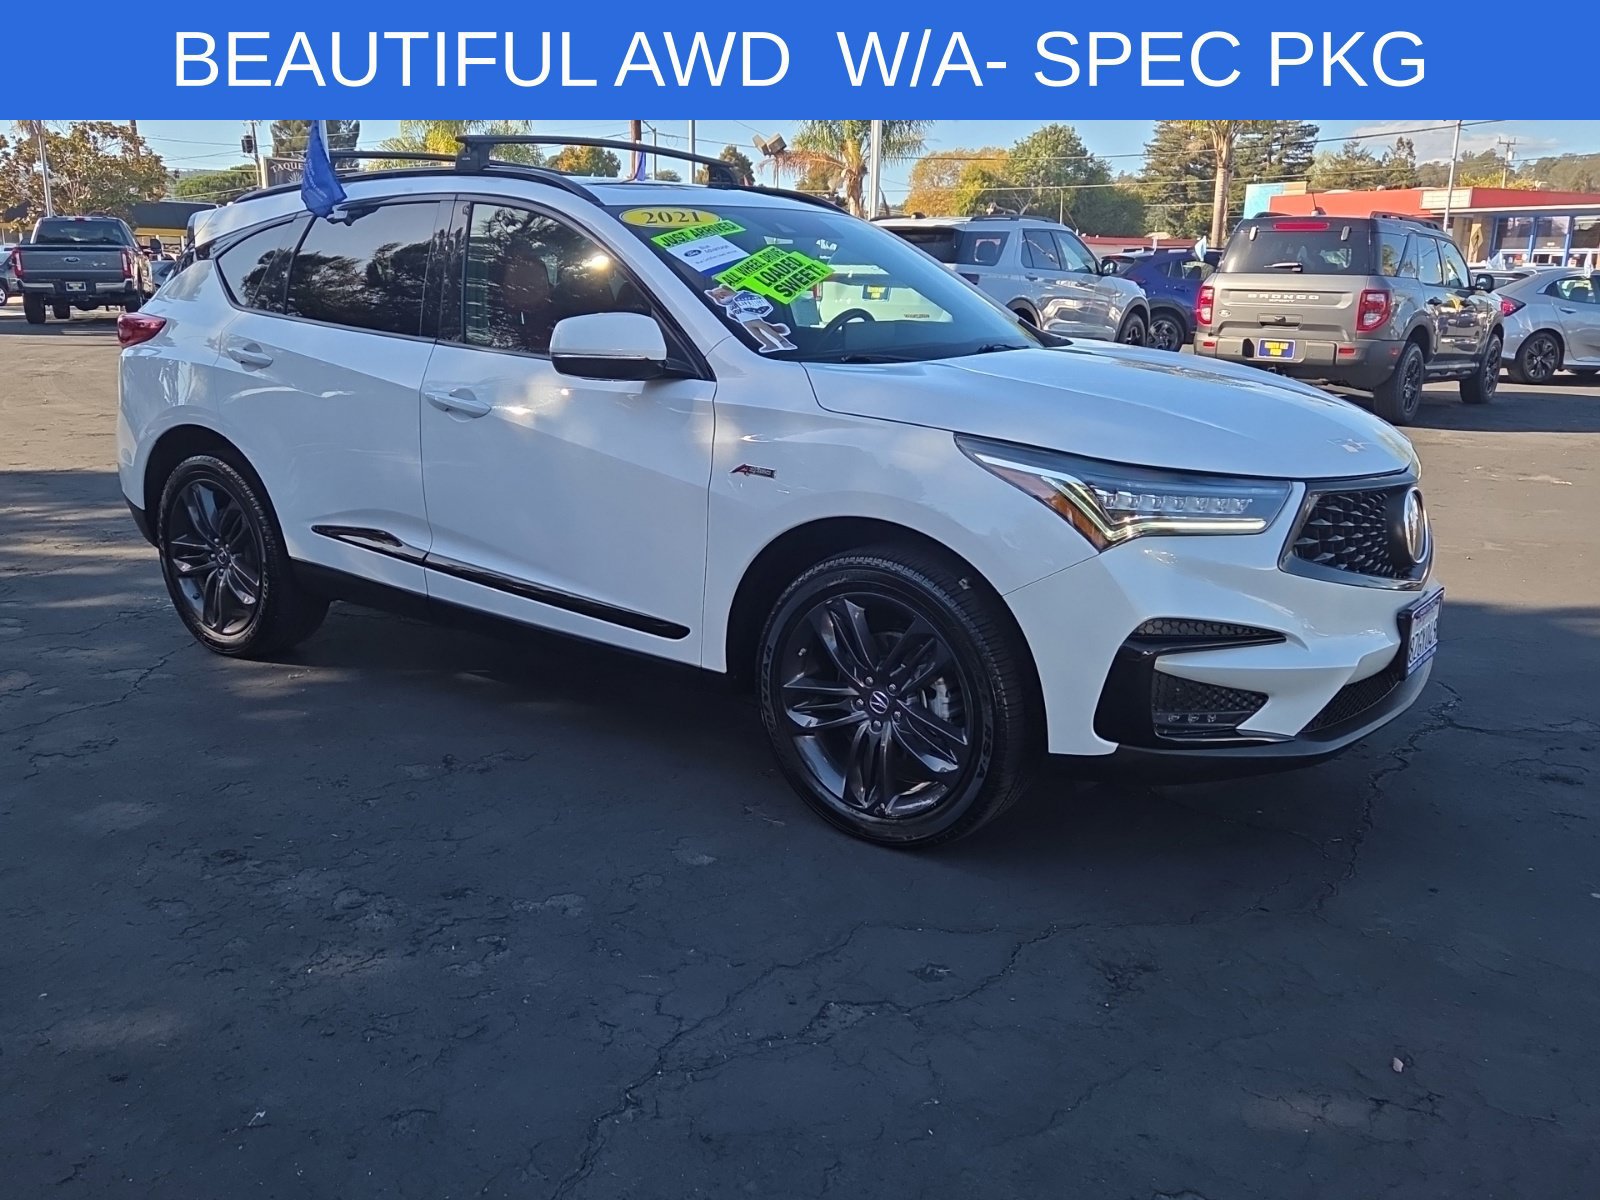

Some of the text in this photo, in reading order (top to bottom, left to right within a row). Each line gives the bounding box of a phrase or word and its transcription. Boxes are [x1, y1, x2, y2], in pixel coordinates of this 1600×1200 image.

[641, 211, 703, 224] 2021
[660, 221, 739, 247] JUST ARRIVED
[721, 247, 788, 286] ALL WHEEL DRIVE
[754, 256, 804, 288] LOADED
[773, 263, 826, 297] SWEET!
